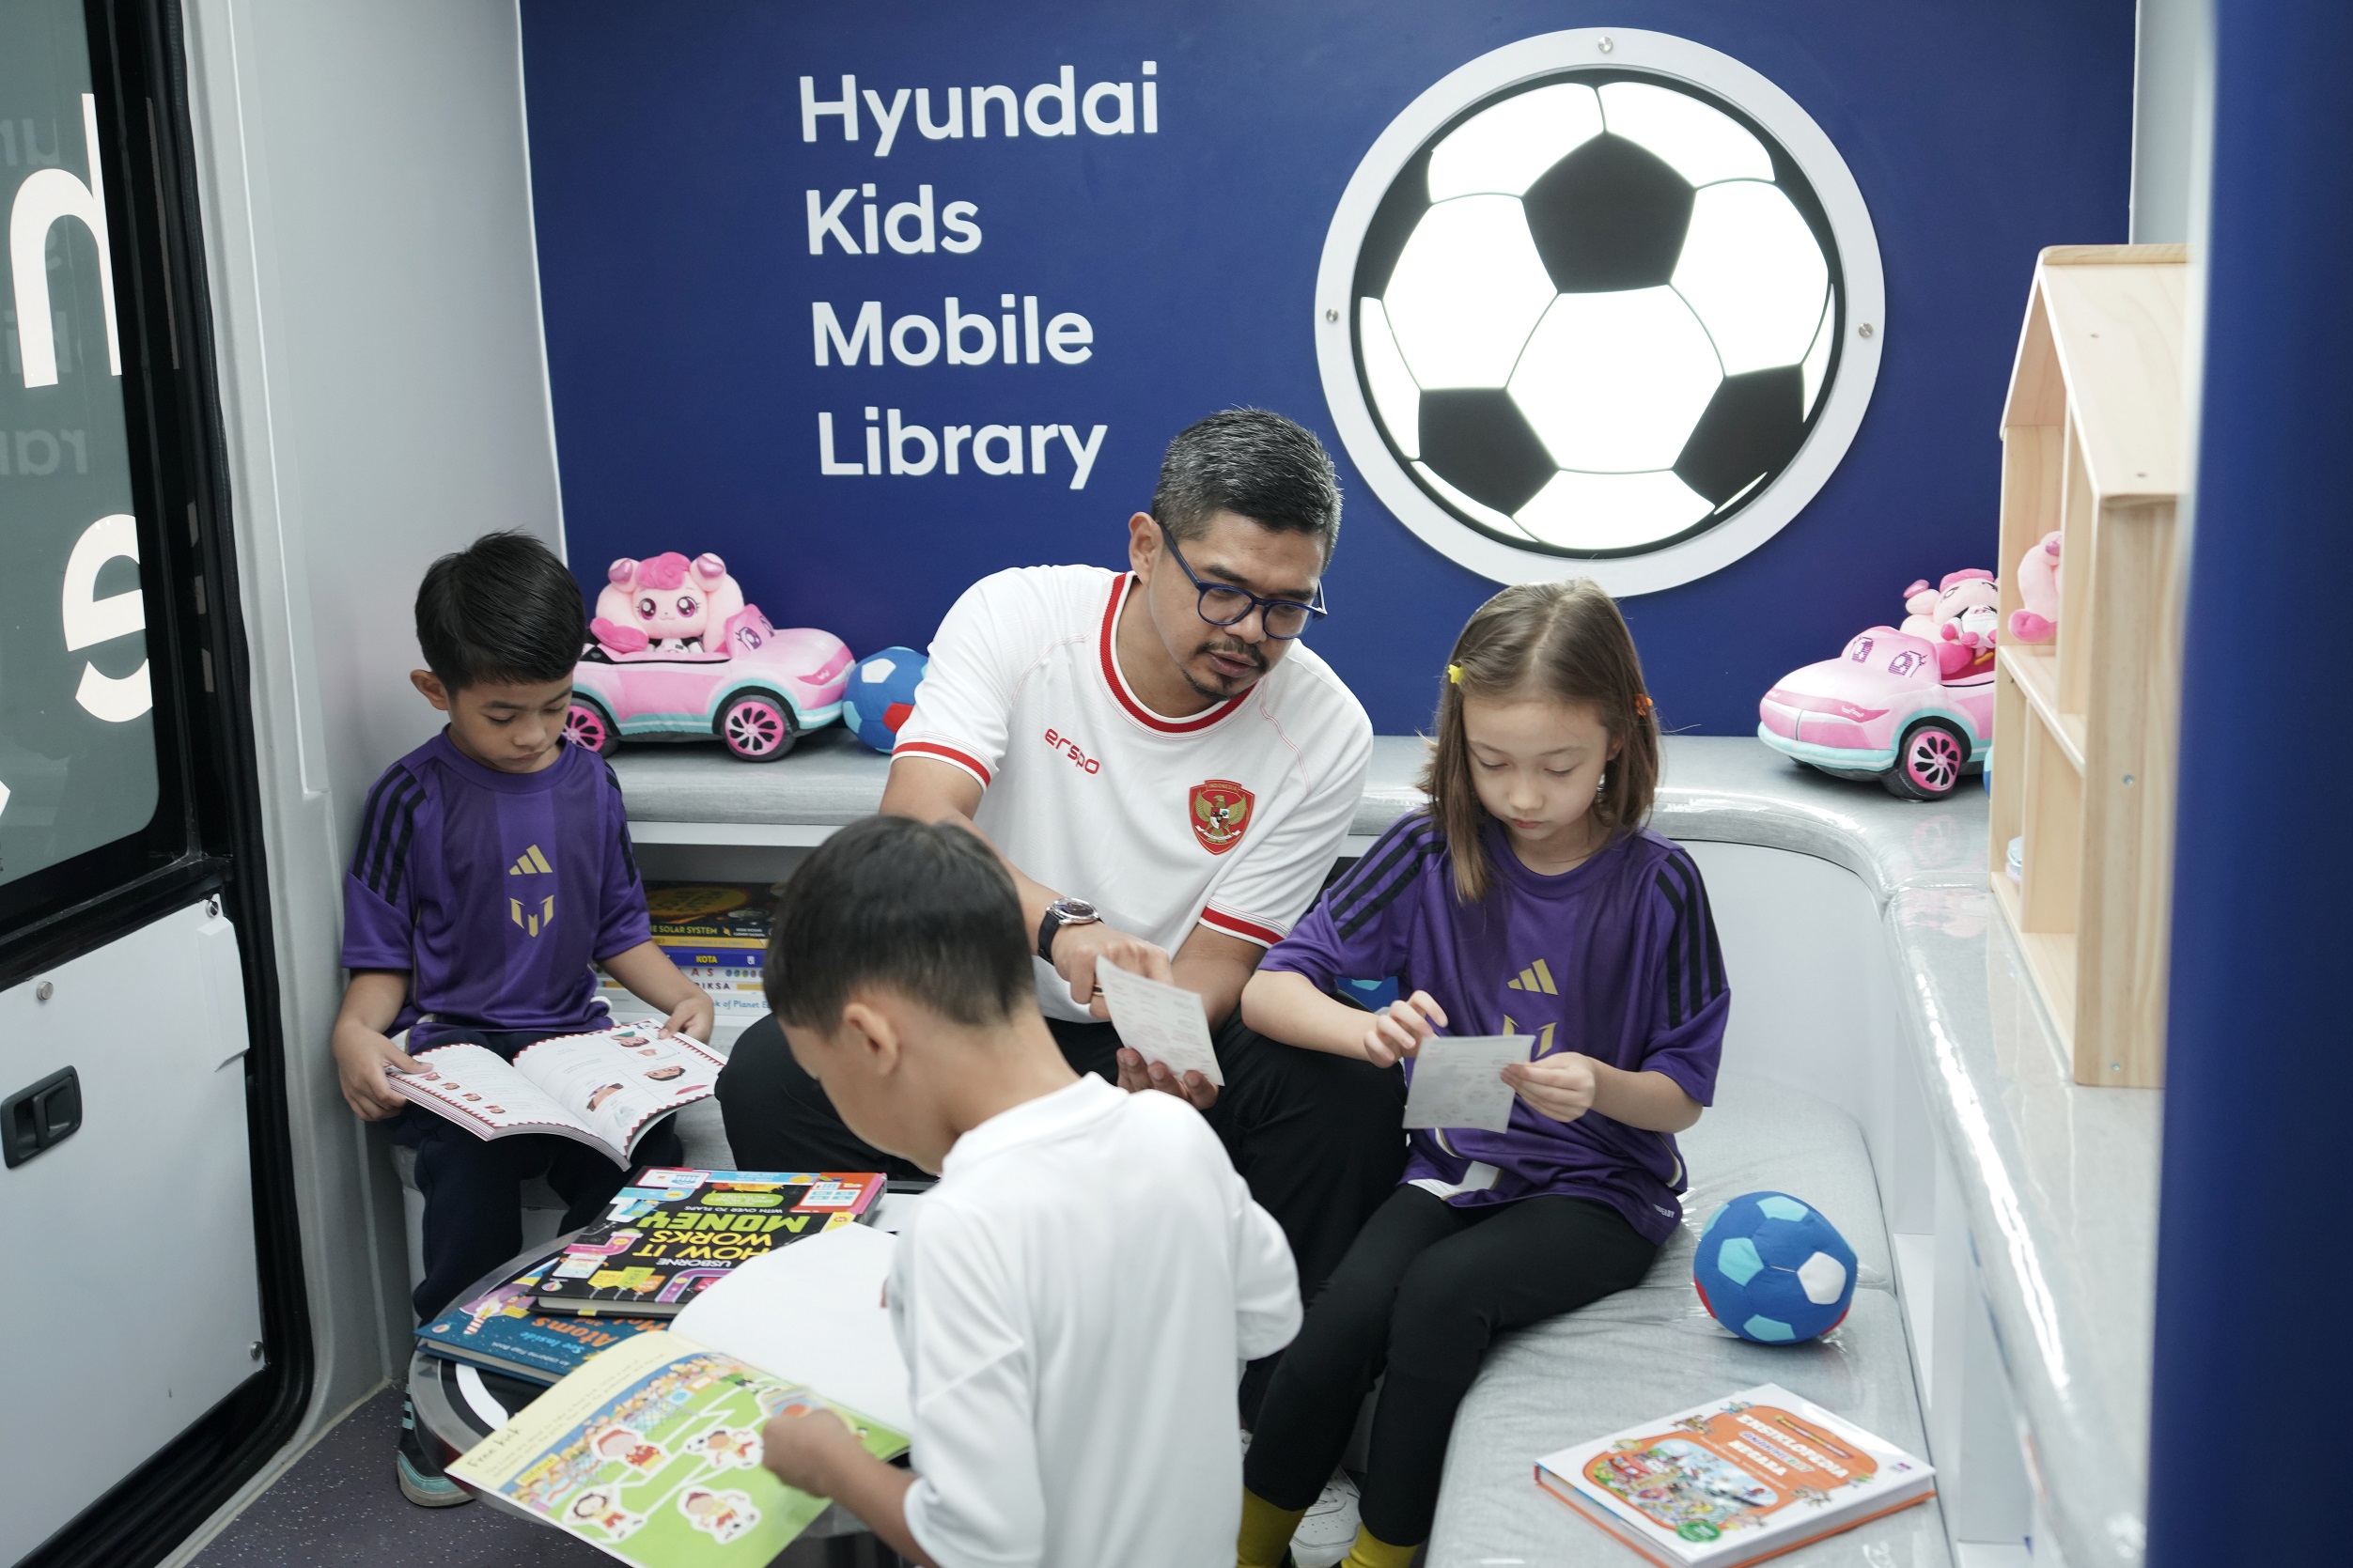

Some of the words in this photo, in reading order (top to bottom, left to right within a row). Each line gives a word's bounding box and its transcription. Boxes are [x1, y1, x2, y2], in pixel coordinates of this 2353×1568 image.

[799, 60, 1159, 157] Hyundai
[805, 182, 983, 256] Kids
[811, 293, 1095, 366] Mobile
[818, 406, 1108, 490] Library
[1043, 728, 1101, 775] erspo
[659, 925, 685, 934] SOLAR
[686, 925, 718, 935] SYSTEM
[695, 955, 718, 964] KOTA
[723, 1000, 732, 1010] of
[733, 1000, 759, 1008] Planet
[636, 1211, 811, 1233] MONEY
[648, 1230, 772, 1247] WORKS
[632, 1243, 667, 1257] IT
[675, 1245, 771, 1260] HOW
[656, 1257, 732, 1267] USBORNE
[520, 1330, 563, 1348] Inside
[531, 1316, 619, 1347] Atoms
[563, 1342, 585, 1355] See
[466, 1446, 494, 1468] Free
[493, 1426, 522, 1447] kick
[1736, 1413, 1849, 1479] ENSIKLOPEDIA
[1727, 1439, 1787, 1477] NEGARA
